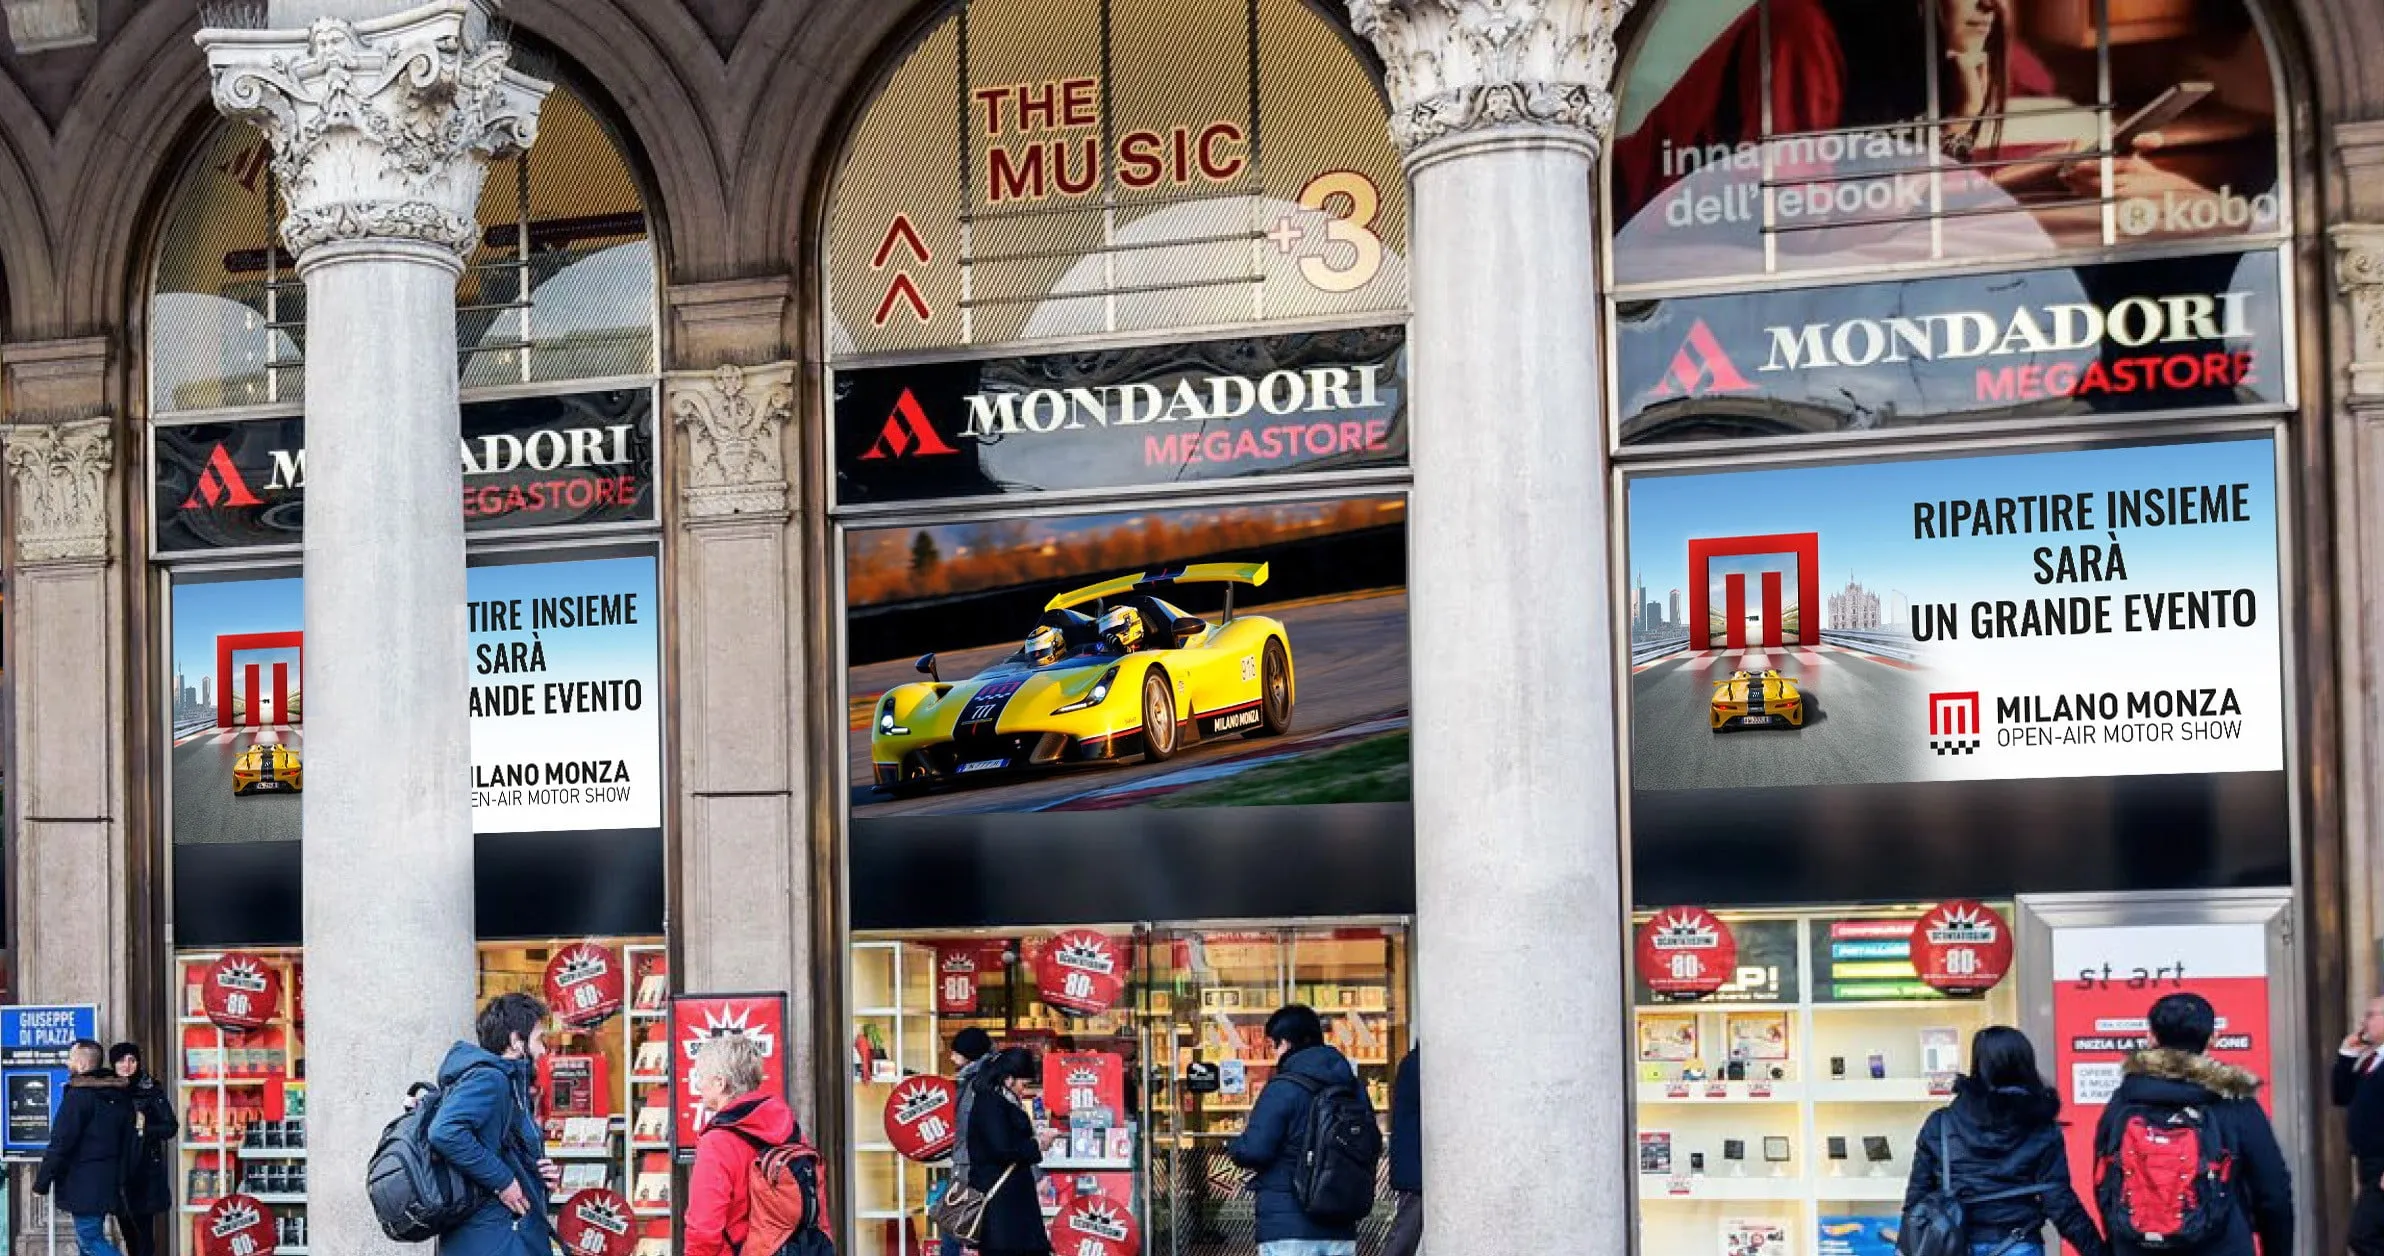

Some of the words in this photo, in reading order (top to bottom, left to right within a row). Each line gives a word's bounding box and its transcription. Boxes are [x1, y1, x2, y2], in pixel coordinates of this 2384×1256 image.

[975, 78, 1097, 134] THE
[2164, 185, 2278, 231] kobo
[1757, 292, 2255, 371] MONDADORI
[1976, 350, 2260, 401] MEGASTORE
[957, 364, 1386, 437] MONDADORI
[1144, 420, 1389, 467] MEGASTORE
[462, 475, 637, 518] EGASTORE
[1914, 492, 2095, 539] RIPARTIRE
[2107, 483, 2251, 529] INSIEME
[2033, 532, 2128, 585] SARÀ
[532, 593, 638, 629] INSIEME
[1911, 603, 1957, 642] UN
[1971, 595, 2112, 639] GRANDE
[2124, 588, 2257, 631] EVENTO
[476, 632, 547, 675] SARÀ
[470, 684, 535, 718] ANDE
[544, 678, 642, 715] EVENTO
[1997, 692, 2119, 724] MILANO
[2127, 688, 2242, 719] MONZA
[1214, 714, 1240, 732] MILANO
[1239, 709, 1260, 726] MONZA
[1997, 724, 2096, 748] OPEN-AIR
[2104, 721, 2174, 743] MOTOR
[2181, 720, 2243, 741] SHOW
[545, 760, 631, 785] MONZA
[471, 787, 523, 807] EN-AIR
[528, 787, 580, 805] MOTOR
[585, 786, 631, 803] SHOW
[19, 1011, 76, 1027] GIUSEPPE
[20, 1029, 32, 1045] DI
[36, 1028, 77, 1046] PIAZZA
